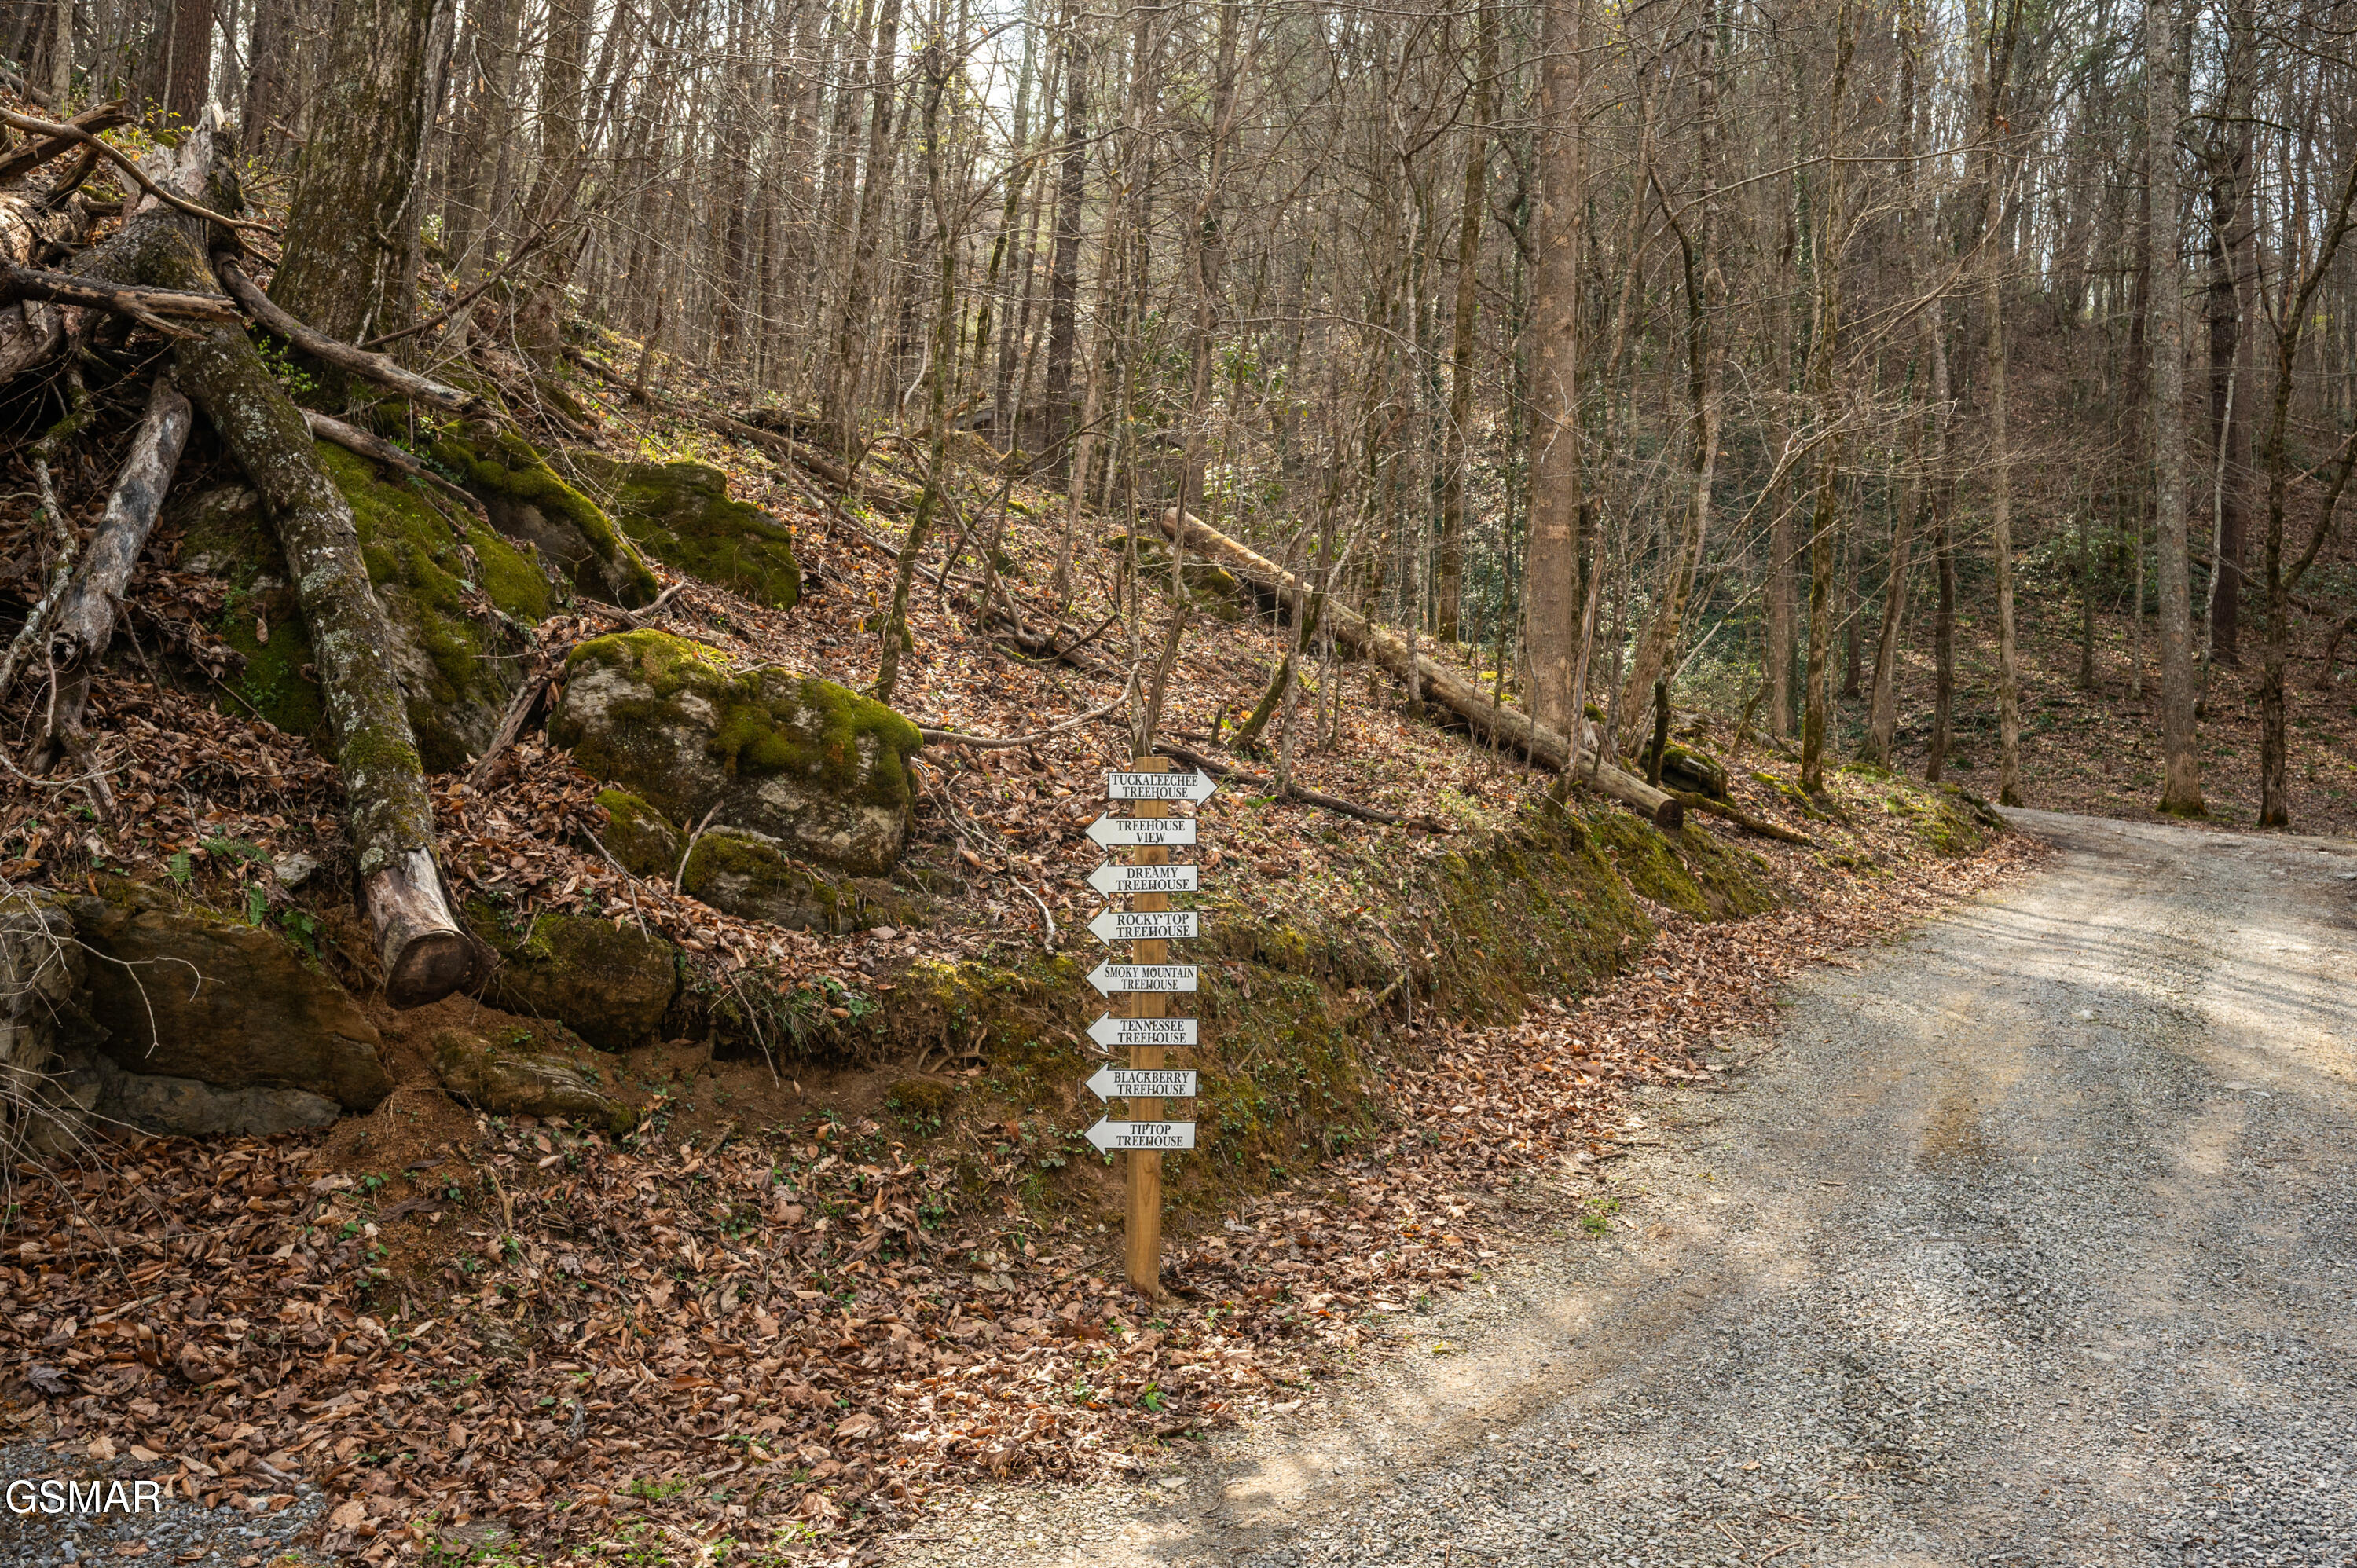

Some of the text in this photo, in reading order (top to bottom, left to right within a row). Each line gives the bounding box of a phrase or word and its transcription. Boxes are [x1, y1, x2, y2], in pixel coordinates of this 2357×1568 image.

[1112, 775, 1198, 786] TUCKALEECHEE
[1123, 786, 1188, 797] TREEHOUSE
[1116, 821, 1185, 831] TREEHOUSE
[1137, 833, 1165, 843] VIEW
[1127, 867, 1178, 878] DREAMY
[1116, 879, 1189, 890] TREEHOUSE
[1117, 914, 1189, 925] ROCKY TOP
[1116, 926, 1189, 937] TREEHOUSE
[1105, 967, 1194, 978] SMOKY MOUNTAIN
[1121, 979, 1178, 990] TREEHOUSE
[1120, 1020, 1184, 1031] TENNESSEE
[1118, 1032, 1186, 1043] TREEHOUSE
[1114, 1072, 1189, 1083] BLACKBERRY
[1117, 1084, 1185, 1094] TREEHOUSE
[1130, 1124, 1171, 1134] TIPTOP
[1116, 1136, 1183, 1146] TREEHOUSE
